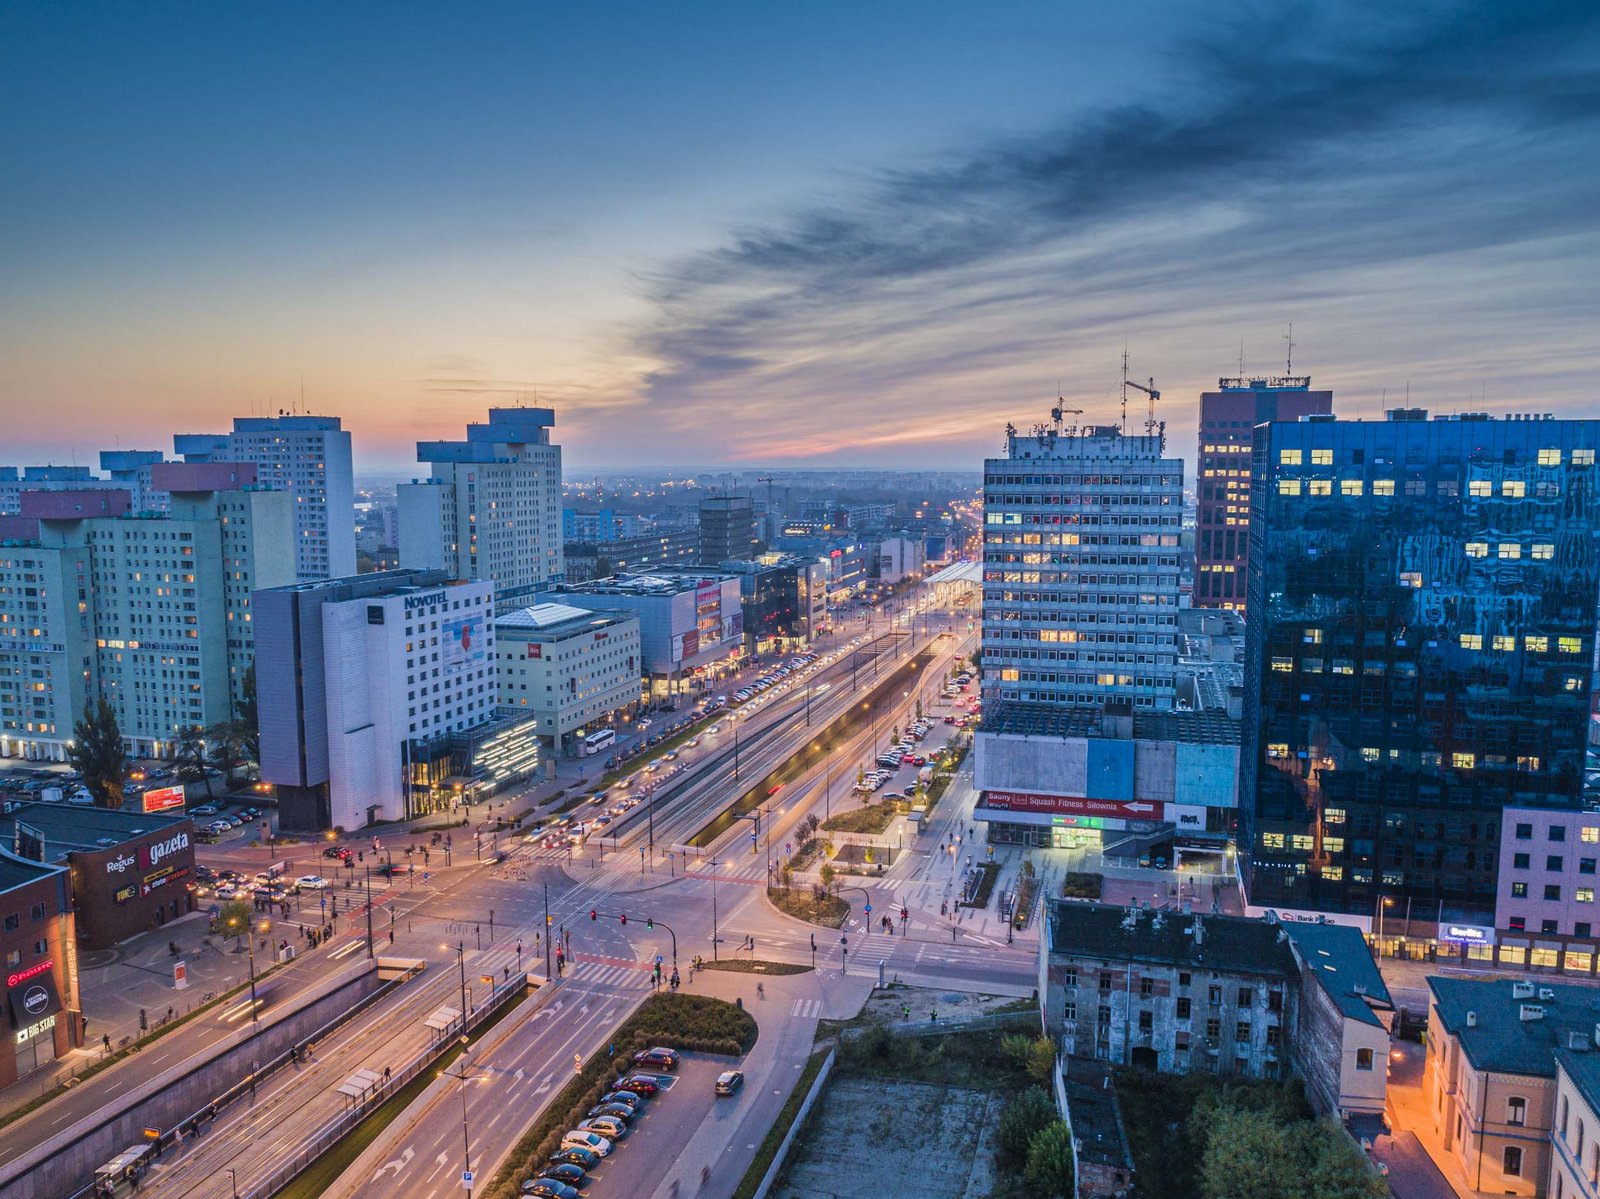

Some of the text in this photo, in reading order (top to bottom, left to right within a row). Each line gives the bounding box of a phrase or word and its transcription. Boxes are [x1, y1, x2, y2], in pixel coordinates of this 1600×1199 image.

[405, 591, 449, 609] NOVOTEL
[988, 793, 1011, 802] Sauny
[1029, 797, 1056, 806] Squash
[1058, 799, 1084, 808] Fitness
[150, 832, 189, 865] gazeta
[106, 855, 135, 873] Regus
[1297, 914, 1314, 922] Bank
[28, 1015, 56, 1039] BIG STAR
